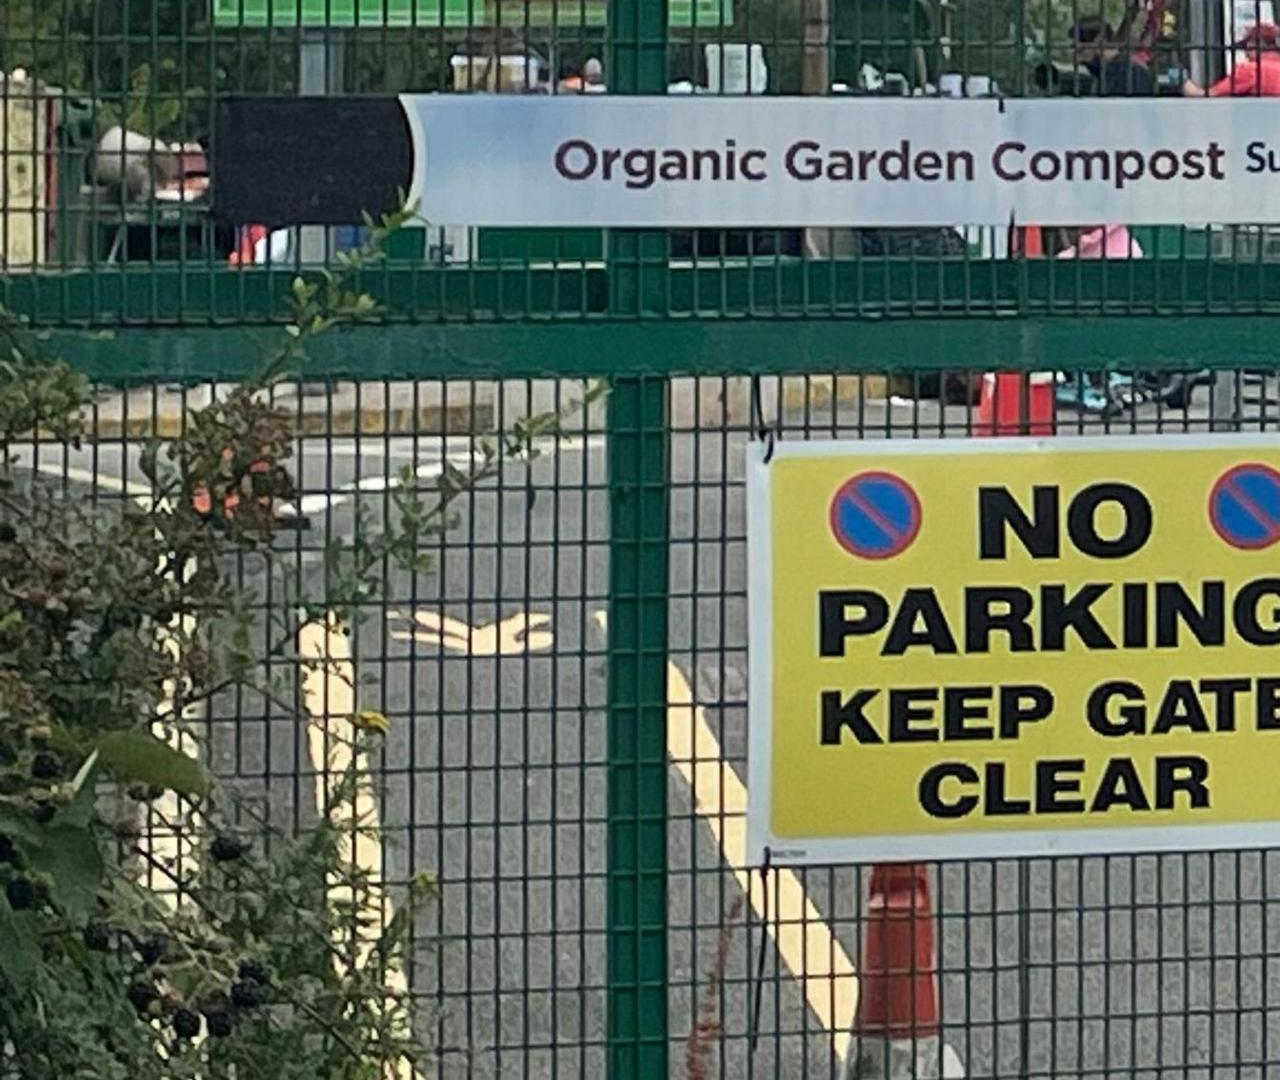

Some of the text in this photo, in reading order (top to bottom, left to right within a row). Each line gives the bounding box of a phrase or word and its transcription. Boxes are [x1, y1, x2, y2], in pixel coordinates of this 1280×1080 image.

[553, 138, 768, 189] Organic
[784, 138, 975, 182] Garden
[991, 139, 1226, 189] Compost
[978, 481, 1154, 560] NO
[819, 684, 1055, 746] KEEP
[917, 755, 1211, 819] CLEAR
